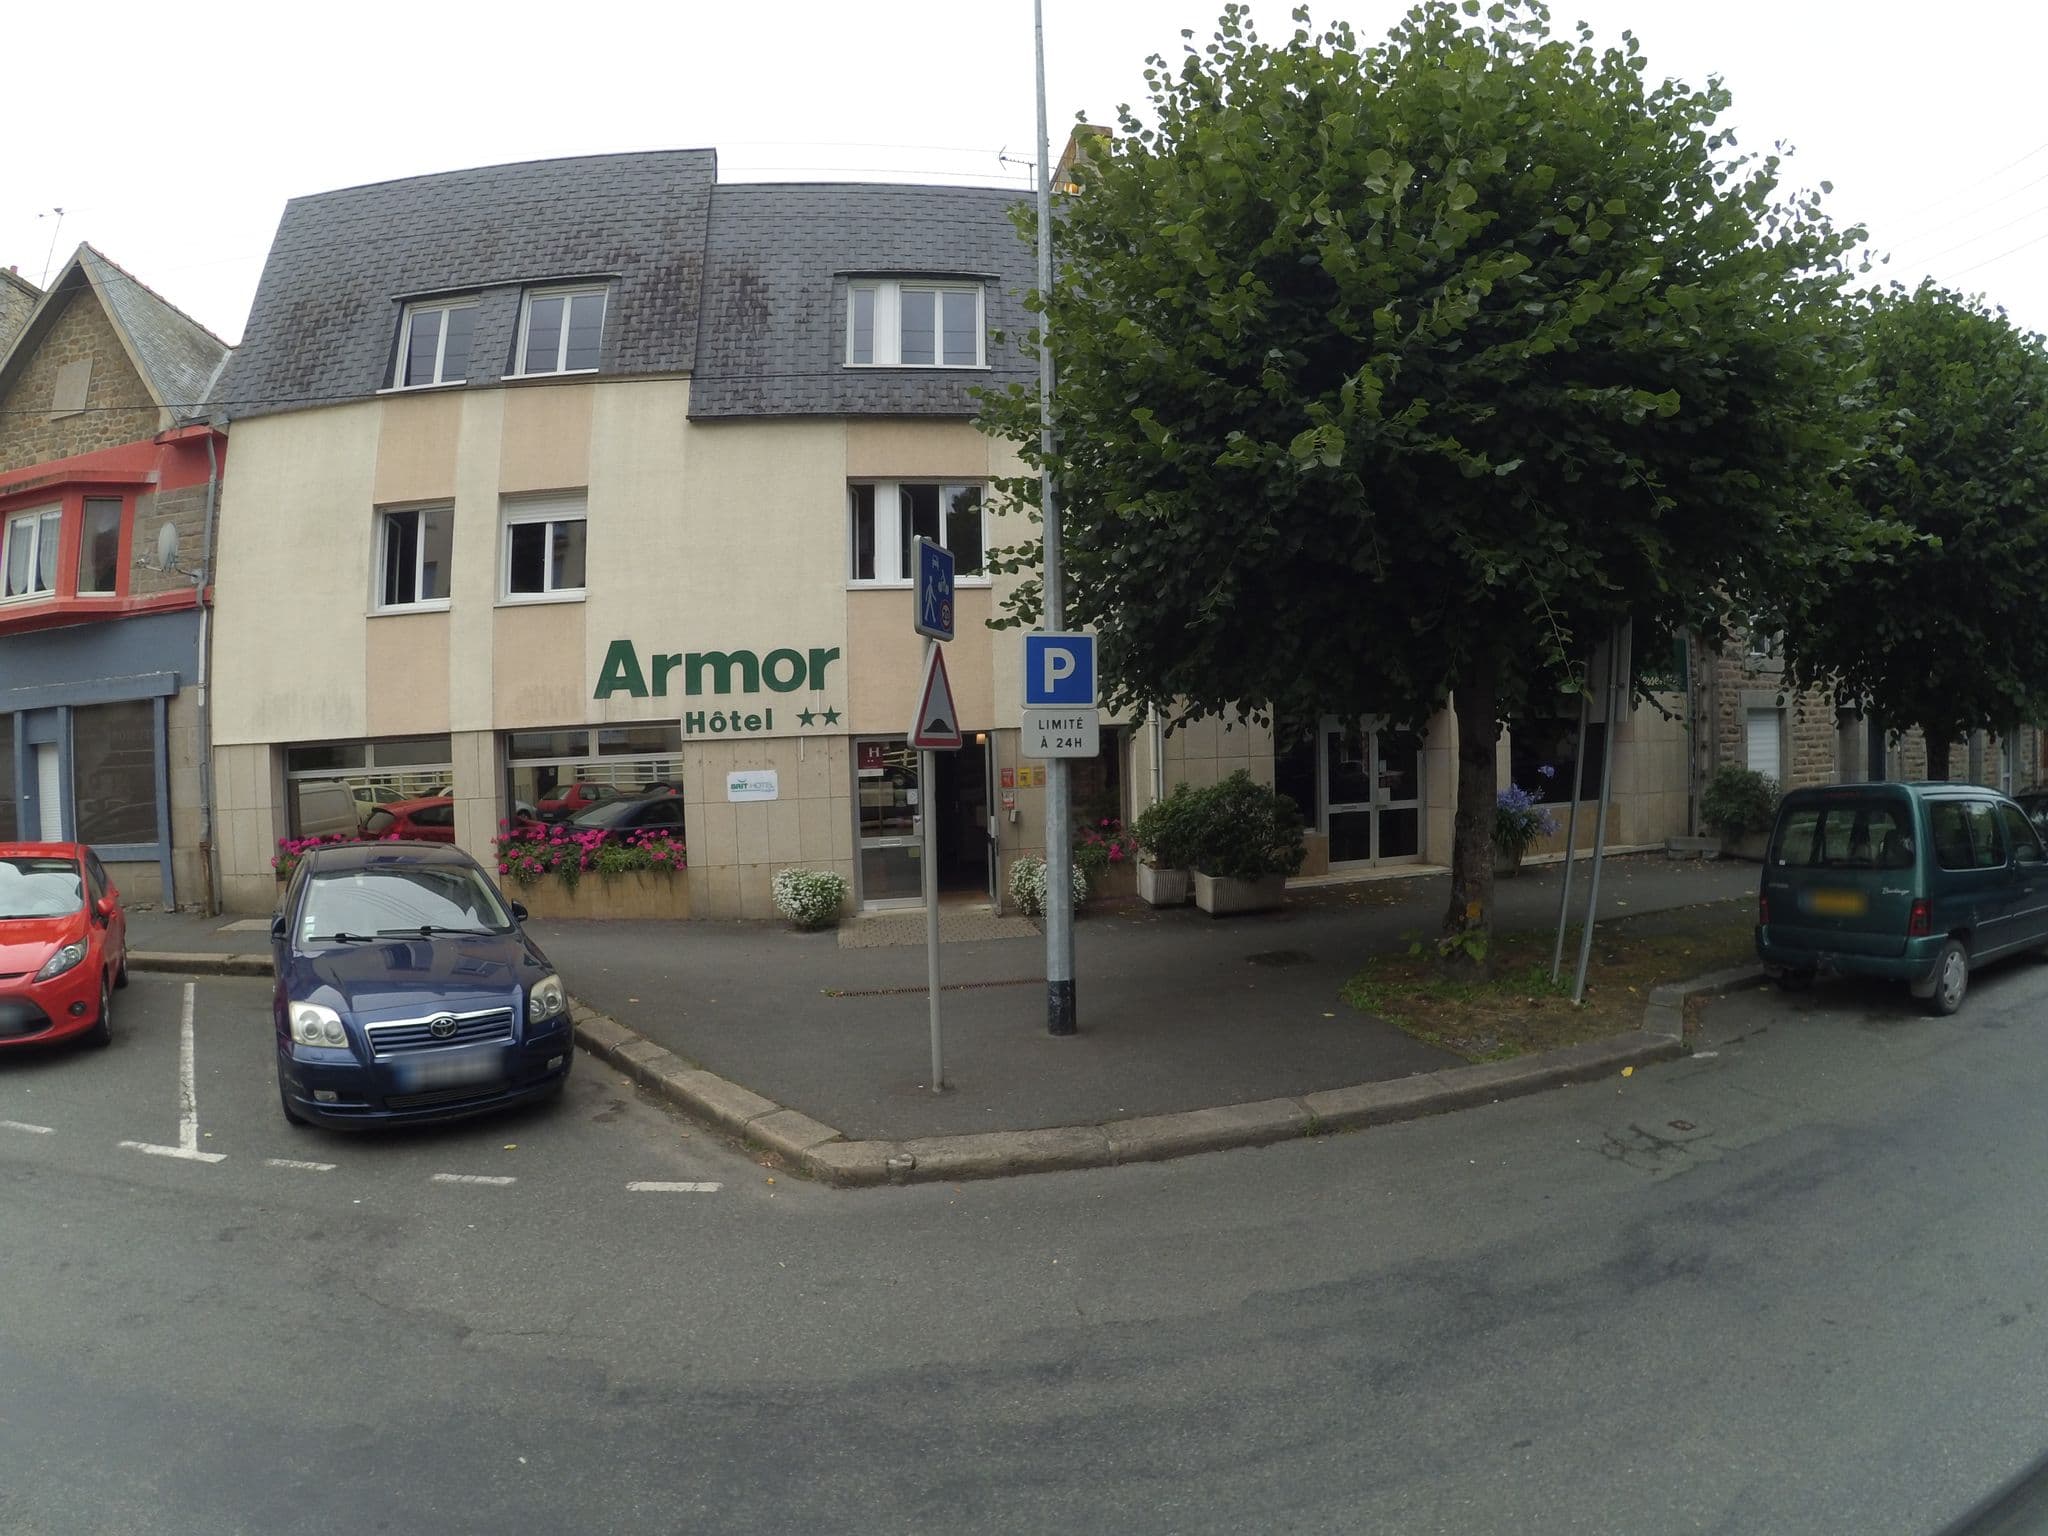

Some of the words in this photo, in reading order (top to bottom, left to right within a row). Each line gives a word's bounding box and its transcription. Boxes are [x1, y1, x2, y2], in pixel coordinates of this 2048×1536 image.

[593, 639, 840, 699] Armor
[1044, 647, 1076, 693] P
[685, 708, 773, 734] Hôtel
[1038, 717, 1083, 730] LIMITÉ
[1040, 736, 1048, 748] À
[1056, 738, 1082, 748] 24H
